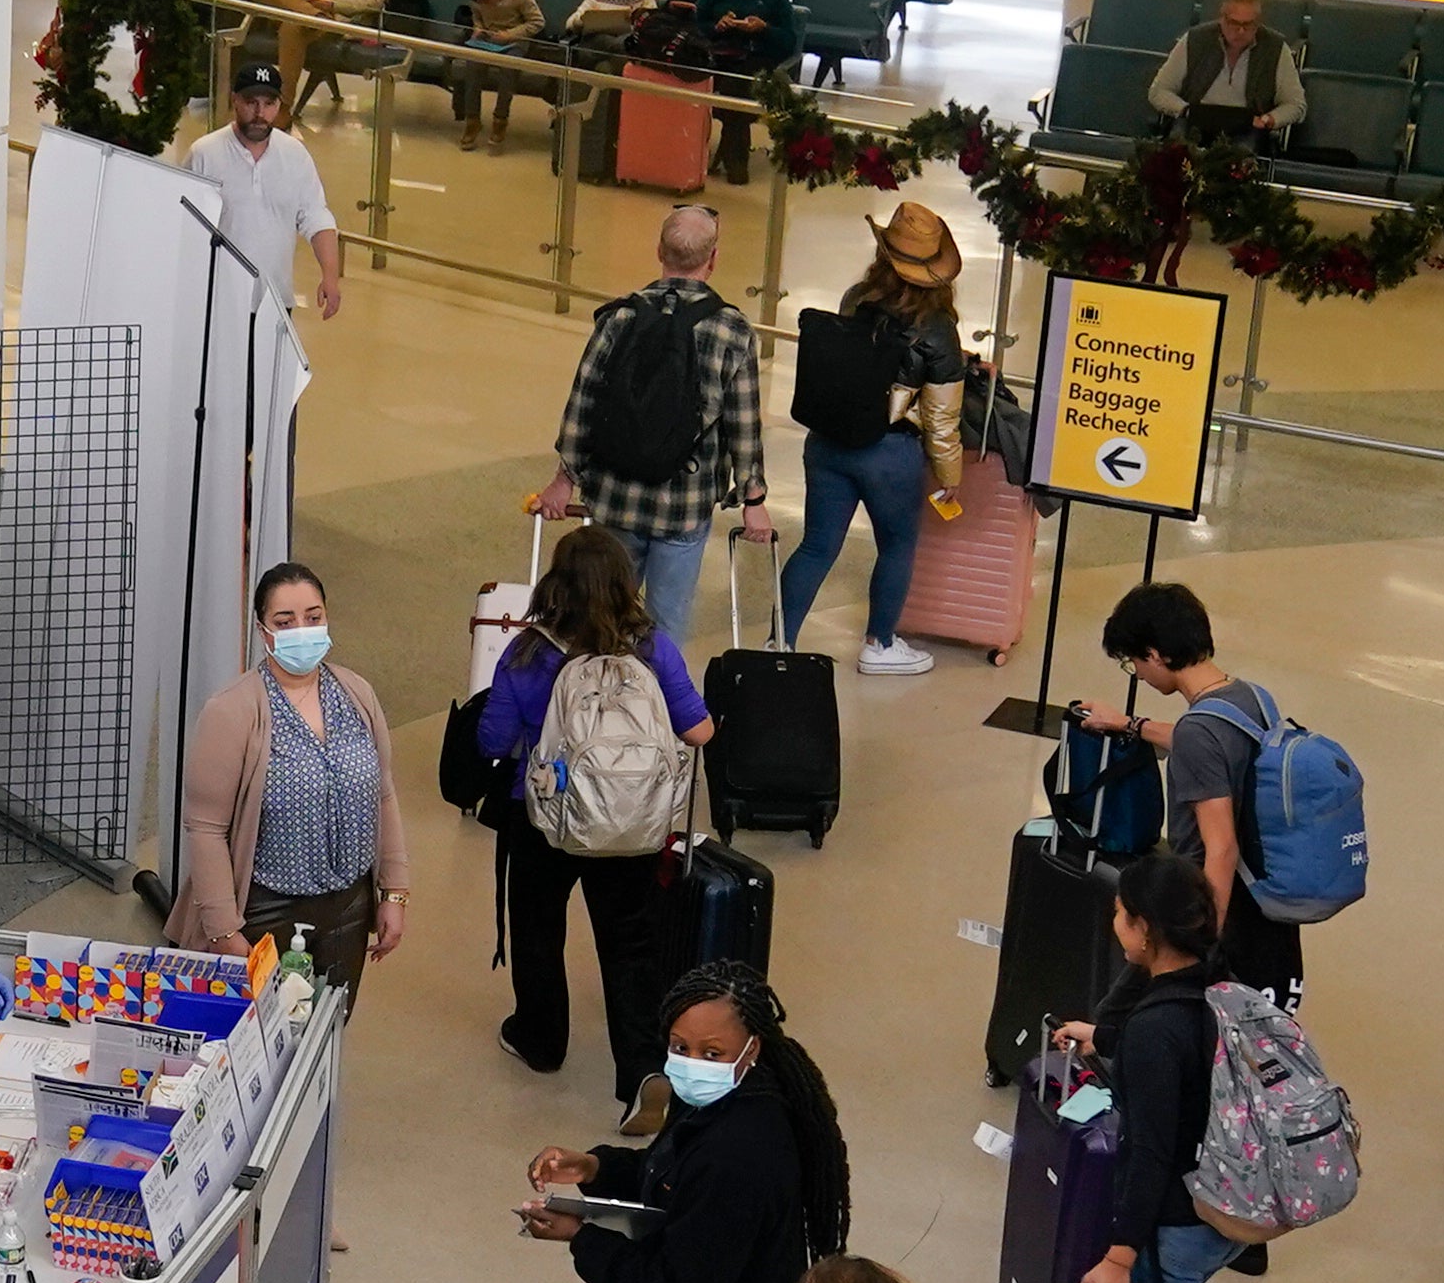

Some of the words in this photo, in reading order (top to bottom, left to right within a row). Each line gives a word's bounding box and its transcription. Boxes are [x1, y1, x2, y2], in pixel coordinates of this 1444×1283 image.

[1074, 331, 1195, 371] Connecting
[1071, 357, 1141, 384] Flights
[1068, 382, 1161, 416] Baggage
[1065, 407, 1150, 437] Recheck
